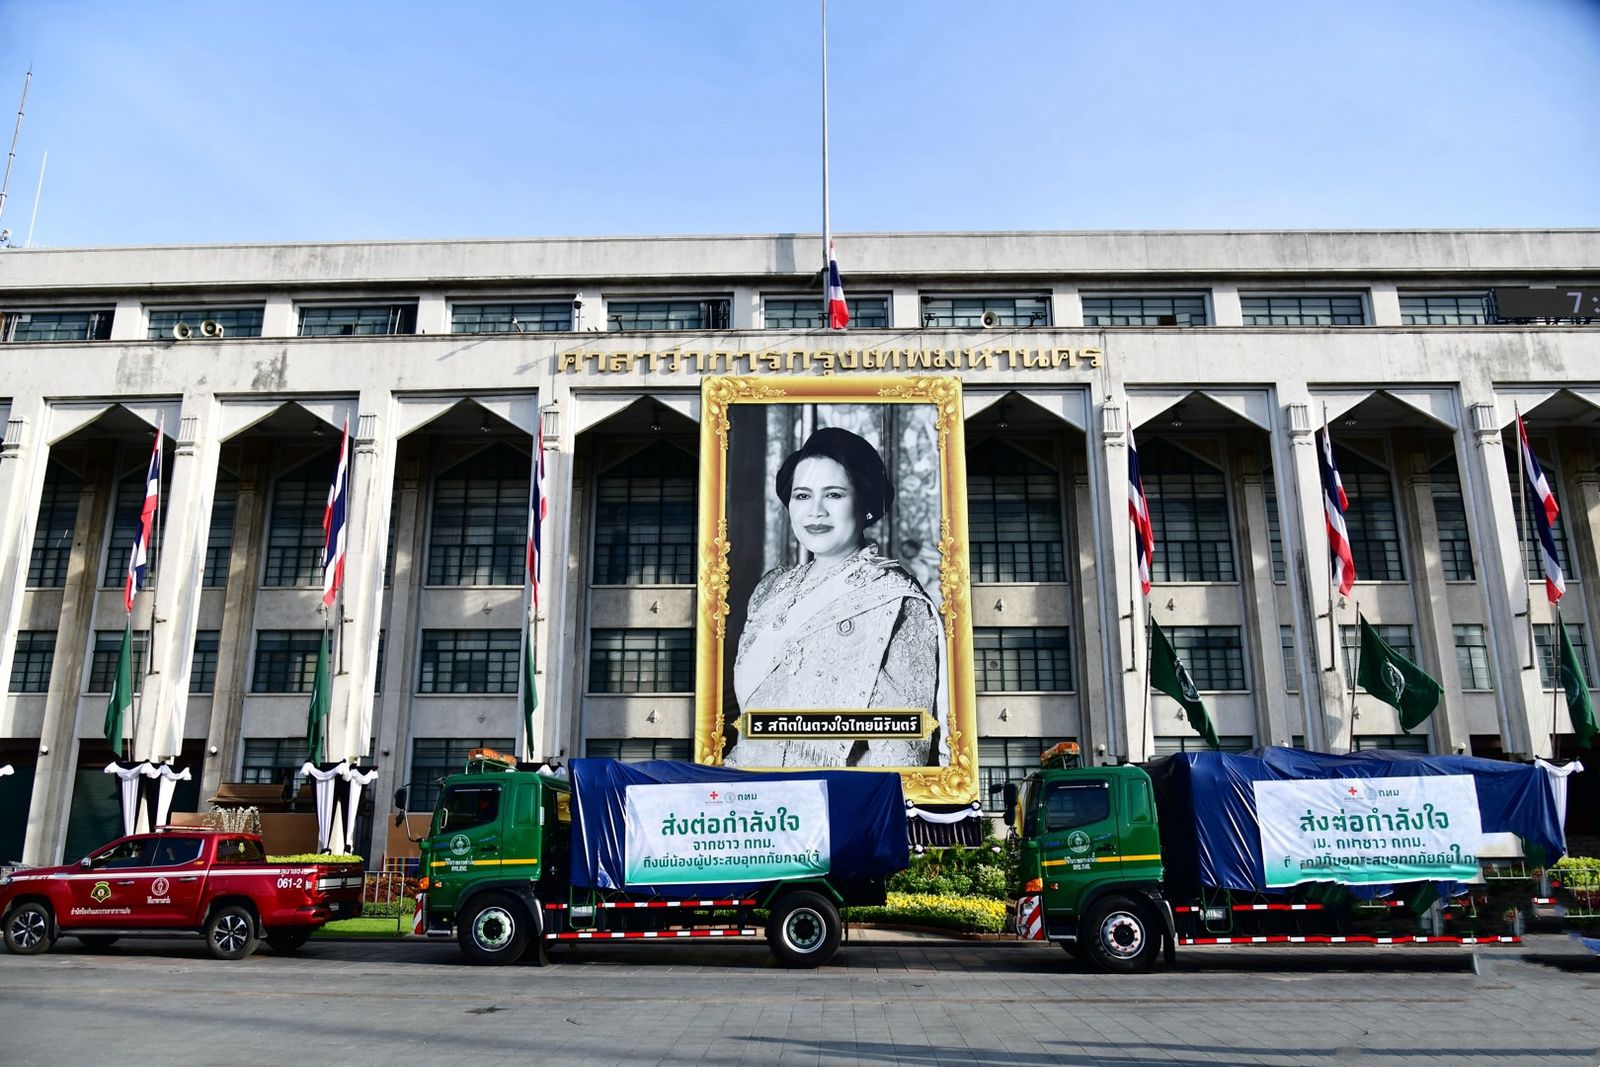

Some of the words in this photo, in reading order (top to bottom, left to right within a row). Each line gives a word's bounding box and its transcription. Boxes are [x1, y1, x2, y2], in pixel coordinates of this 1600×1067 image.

[557, 345, 1103, 376] ศาลาว่าการกรุงเทพมหานคร
[753, 719, 763, 732] ธ
[768, 715, 918, 732] สถิตในดวงใจไทยนิรันดร์
[661, 806, 800, 836] ส่งต่อกำลังใจ
[693, 838, 740, 851] จากชาว
[744, 837, 776, 849] กทม.
[1391, 836, 1426, 849] กทม.
[643, 850, 820, 871] ถึงพี่น้องผู้ประสบอุทกภัยภาคใต้
[277, 877, 303, 889] 061-2
